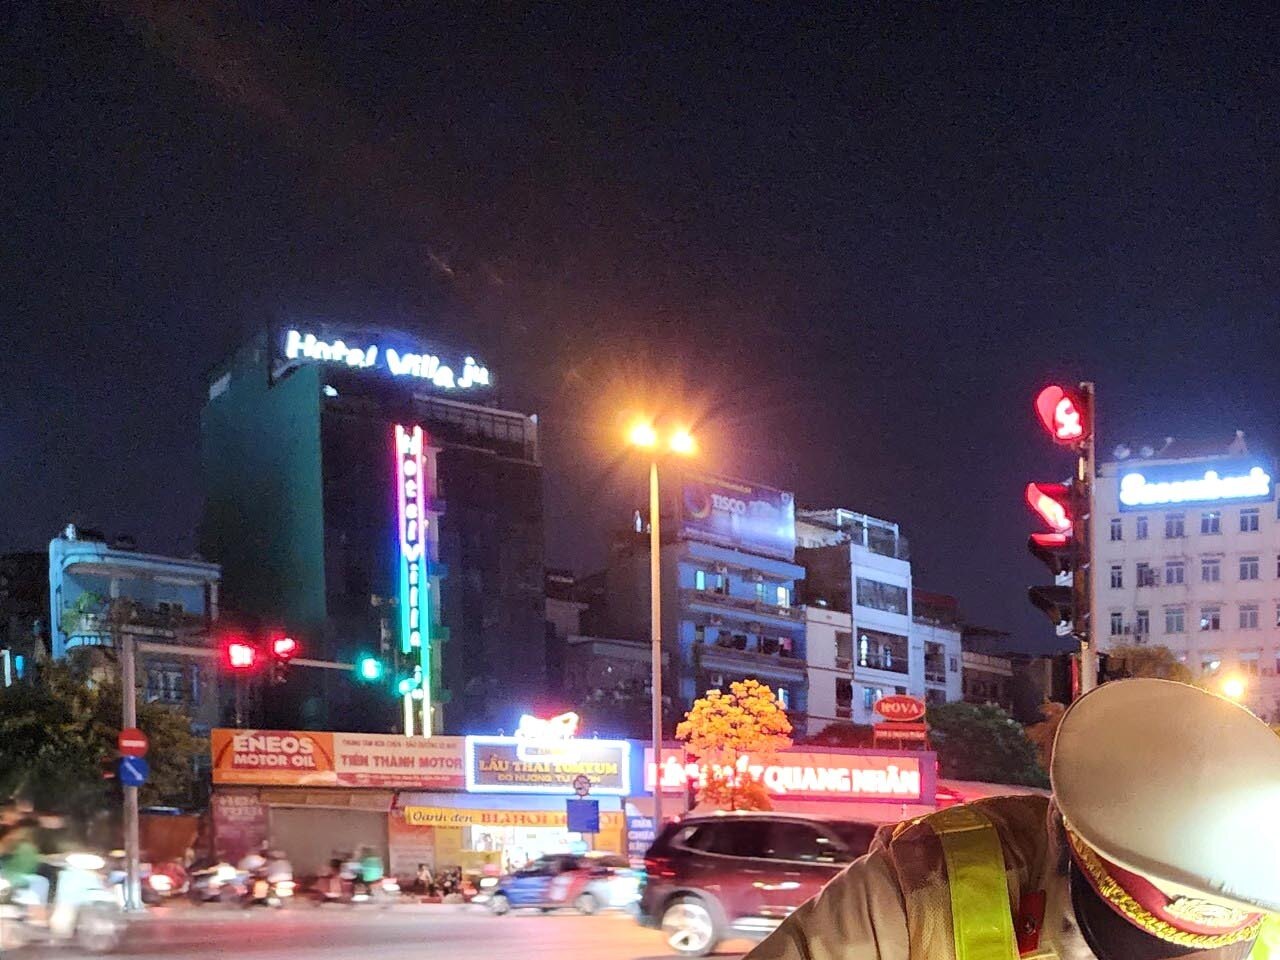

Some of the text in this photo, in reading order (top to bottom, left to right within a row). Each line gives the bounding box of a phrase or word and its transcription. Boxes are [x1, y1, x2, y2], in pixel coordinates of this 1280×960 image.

[286, 329, 378, 368] Hotel
[386, 348, 456, 387] Villa
[232, 735, 314, 755] ENEOS
[233, 753, 316, 768] MOTOR OIL
[418, 755, 463, 769] MOTOR
[763, 765, 851, 794] QUANG
